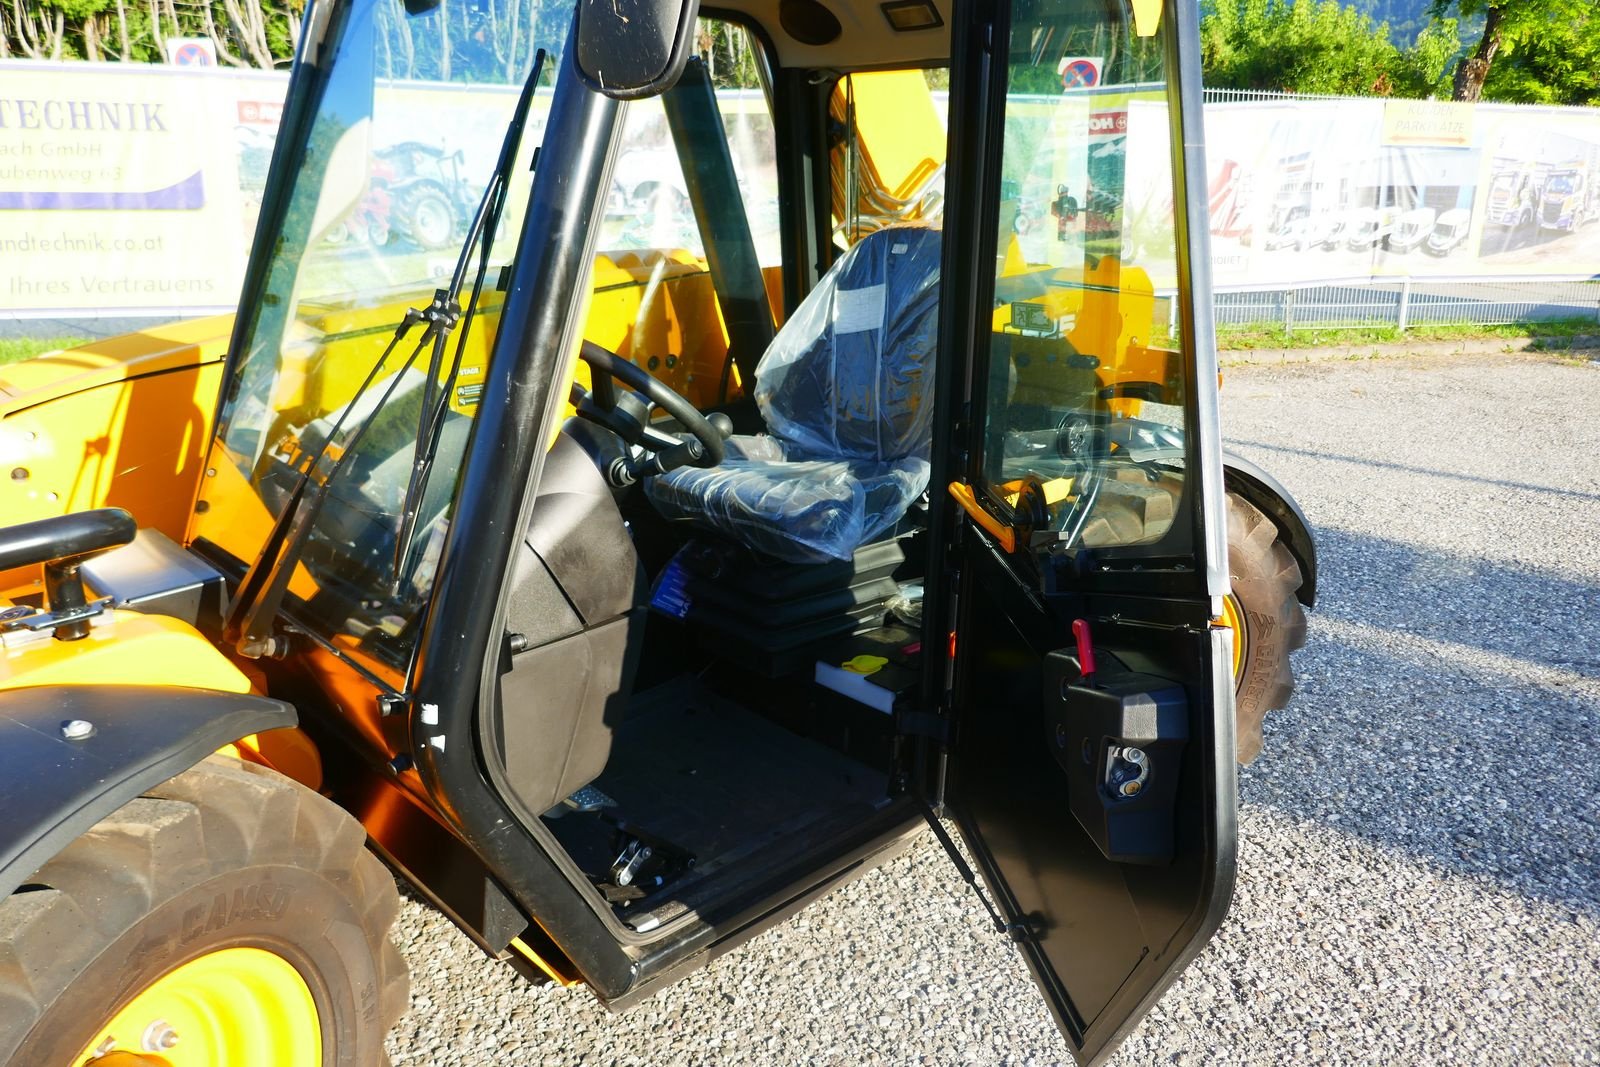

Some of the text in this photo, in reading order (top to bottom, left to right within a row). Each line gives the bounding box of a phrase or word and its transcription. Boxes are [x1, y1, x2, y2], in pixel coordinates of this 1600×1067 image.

[41, 142, 102, 157] GmbH
[10, 276, 214, 295] Ihres Vertrauens
